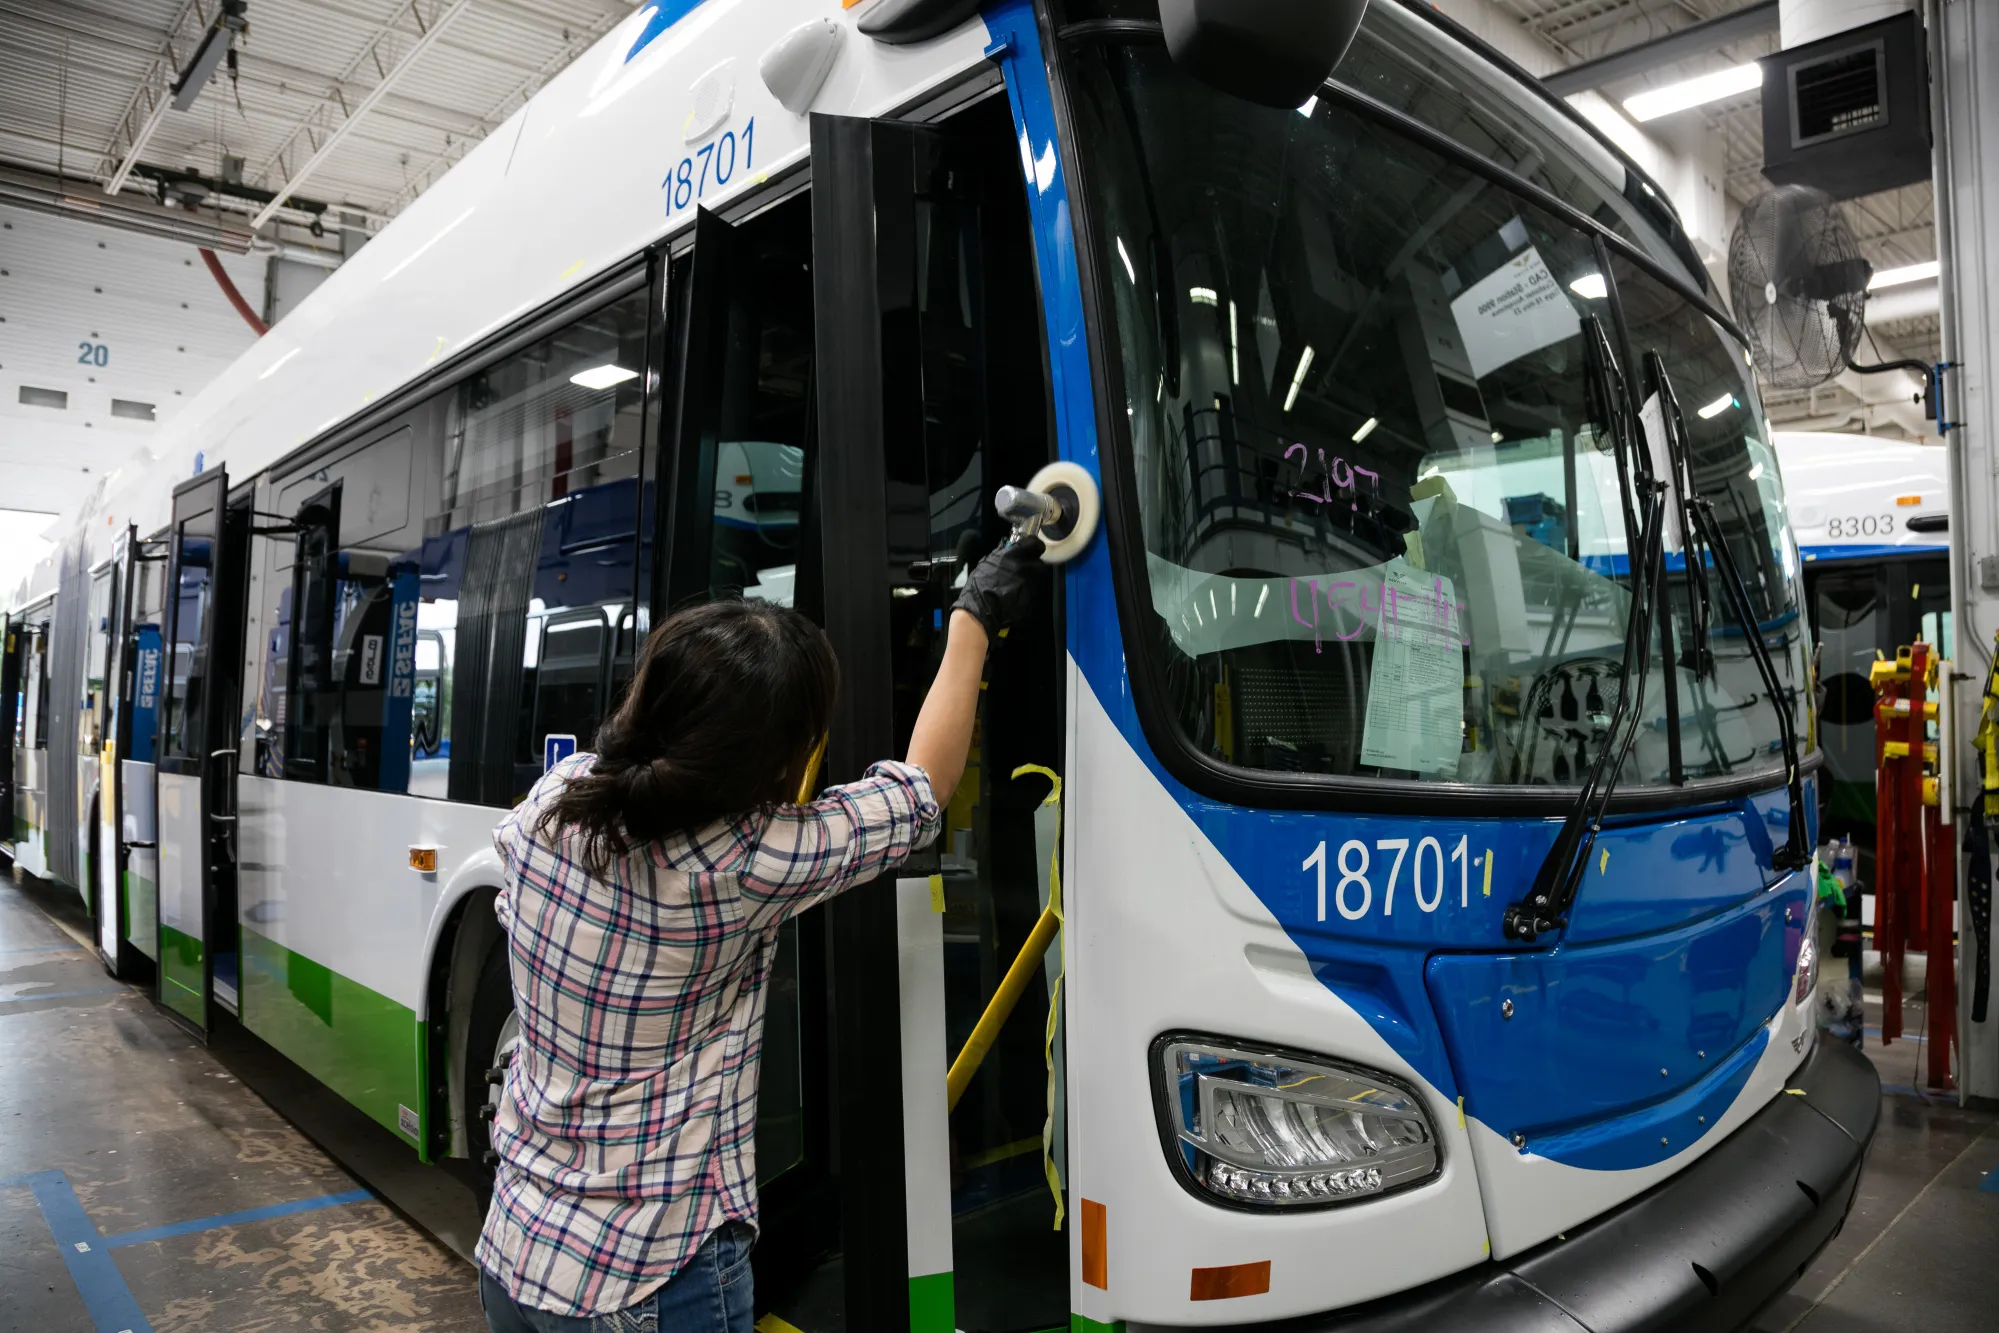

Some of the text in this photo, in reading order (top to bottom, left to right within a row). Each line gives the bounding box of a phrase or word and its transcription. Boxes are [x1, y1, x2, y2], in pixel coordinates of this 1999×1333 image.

[661, 115, 754, 217] 18701
[78, 341, 109, 367] 20
[1828, 513, 1894, 539] 8303
[1302, 834, 1468, 922] 18701
